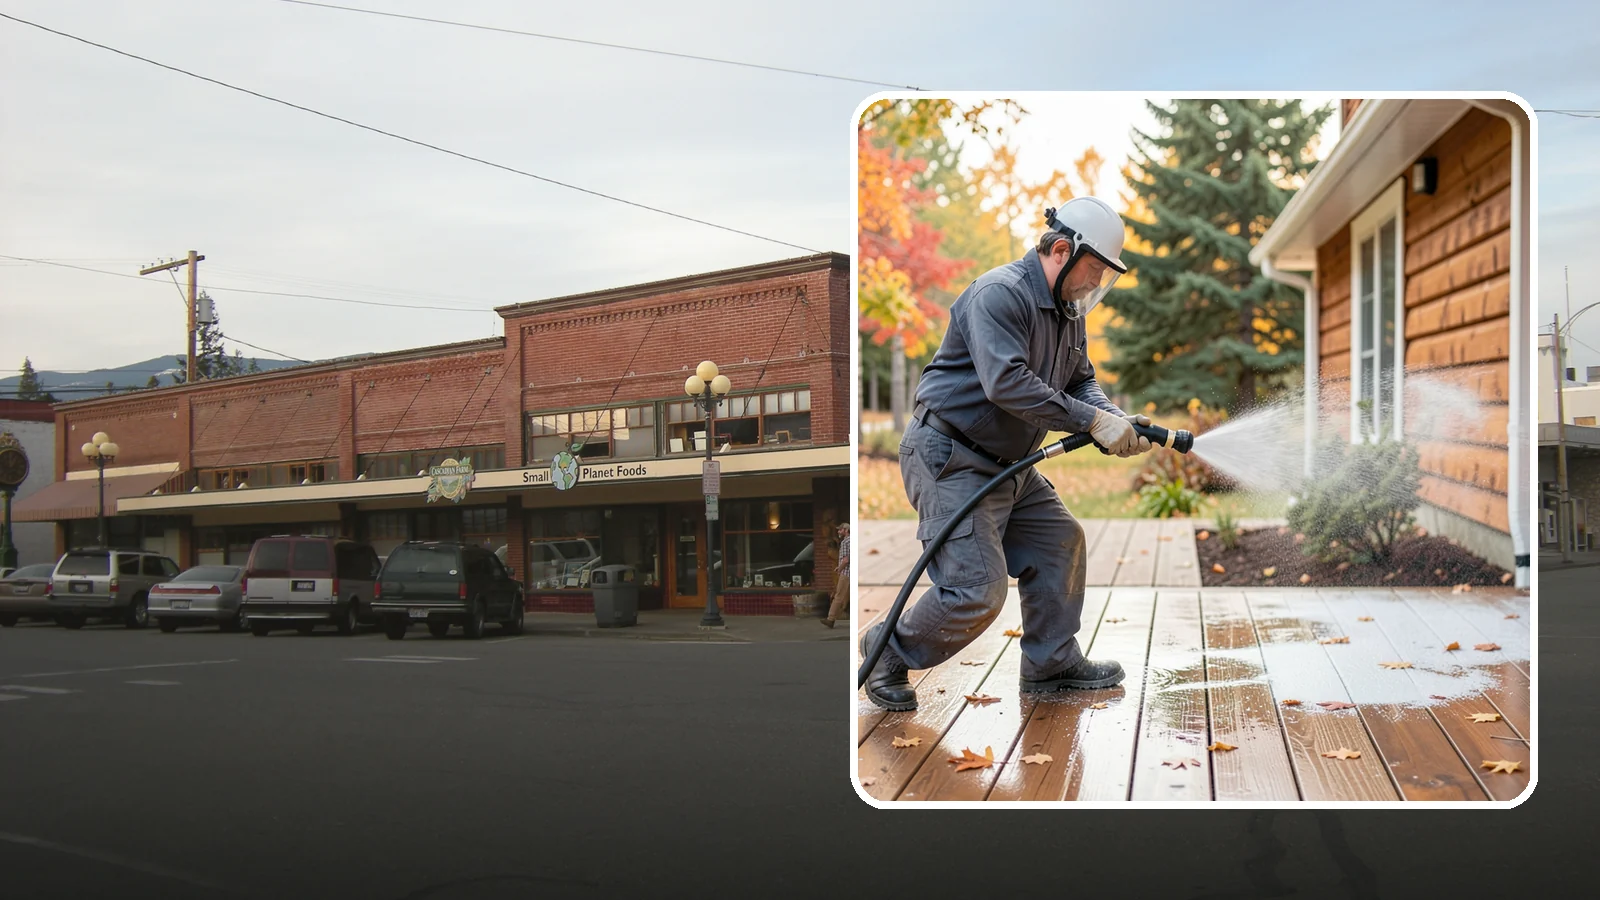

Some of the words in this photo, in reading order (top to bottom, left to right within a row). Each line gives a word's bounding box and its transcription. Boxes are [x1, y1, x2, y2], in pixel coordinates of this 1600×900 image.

[431, 467, 456, 476] CASCADIAN
[456, 465, 469, 474] FARM
[523, 471, 549, 483] Small
[582, 467, 614, 479] Planet
[616, 464, 647, 477] Foods
